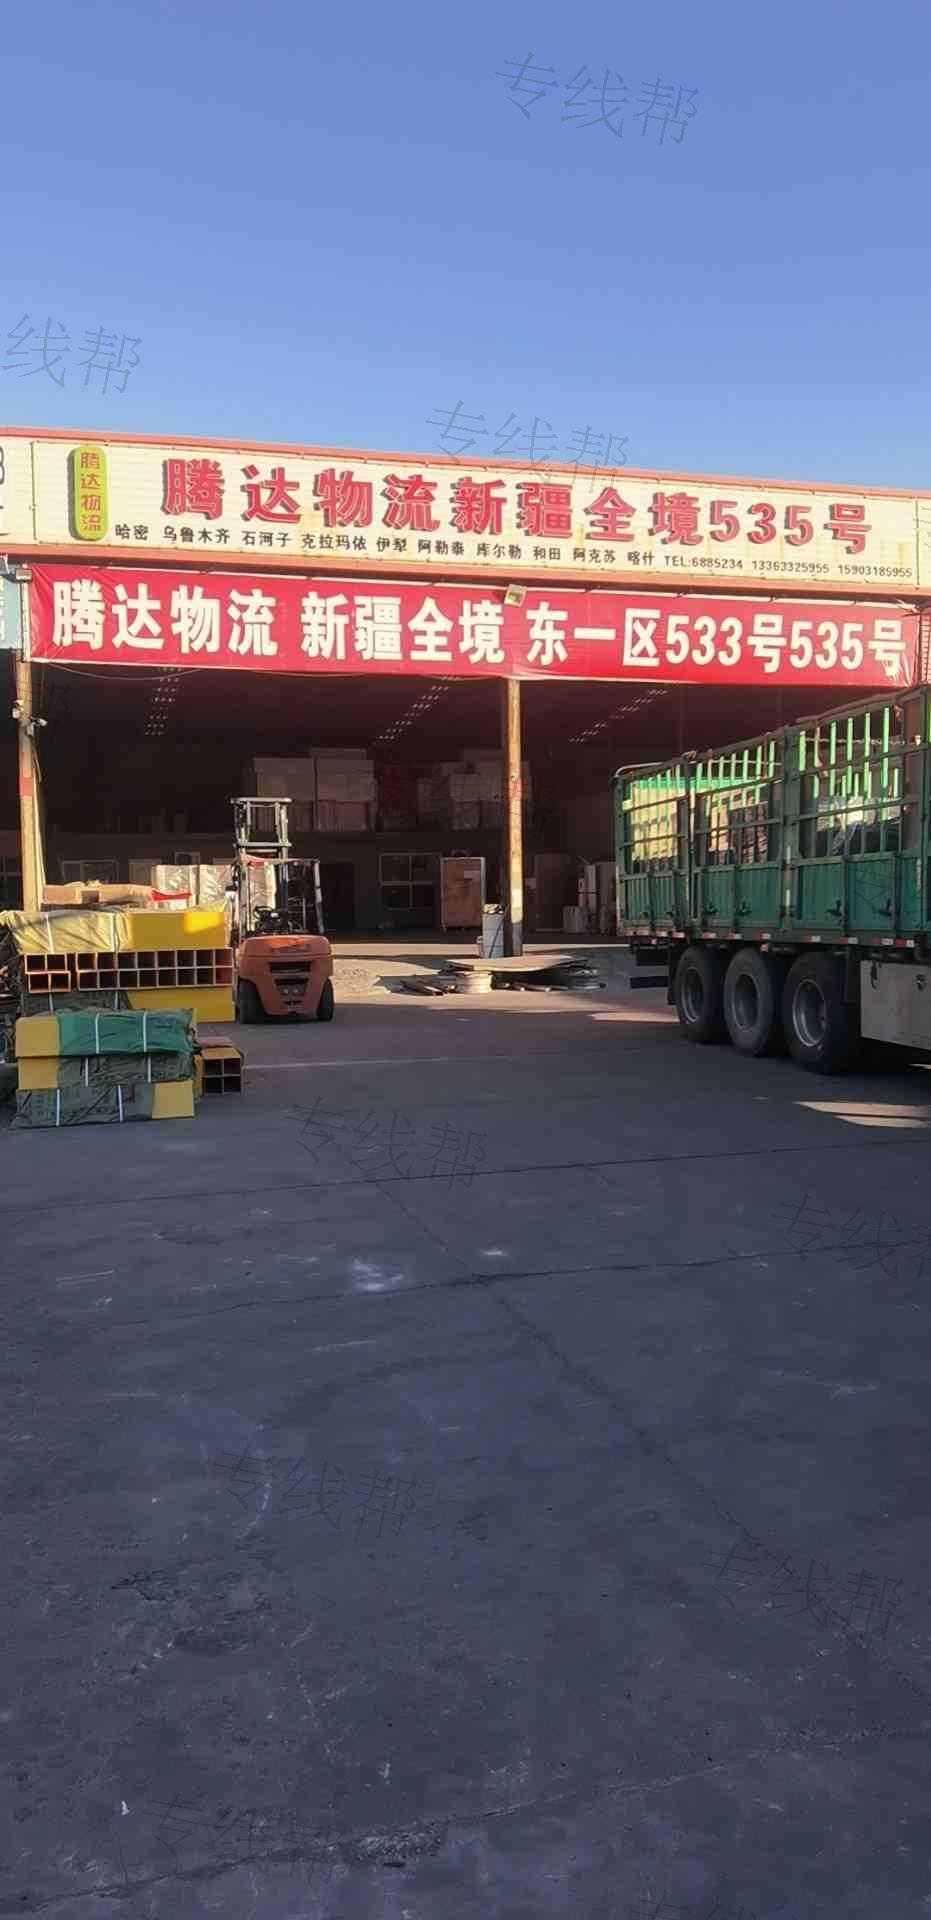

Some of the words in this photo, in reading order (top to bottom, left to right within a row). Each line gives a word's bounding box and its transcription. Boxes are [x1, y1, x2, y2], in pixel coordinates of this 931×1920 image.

[80, 451, 101, 531] 腾达物流
[162, 457, 871, 555] 腾达物流新疆全境535号
[114, 524, 149, 541] 哈密
[163, 525, 231, 545] 乌鲁木齐
[242, 530, 292, 547] 石河子
[301, 534, 367, 551] 克拉玛依
[418, 539, 465, 556] 阿勒泰
[476, 543, 522, 560] 库尔勒
[533, 547, 562, 561] 和田
[573, 548, 617, 564] 阿克苏
[627, 551, 655, 566] 喀什
[52, 579, 278, 657] 腾达物流
[300, 591, 505, 665] 新疆全境
[526, 601, 907, 678] 东一区533号535号
